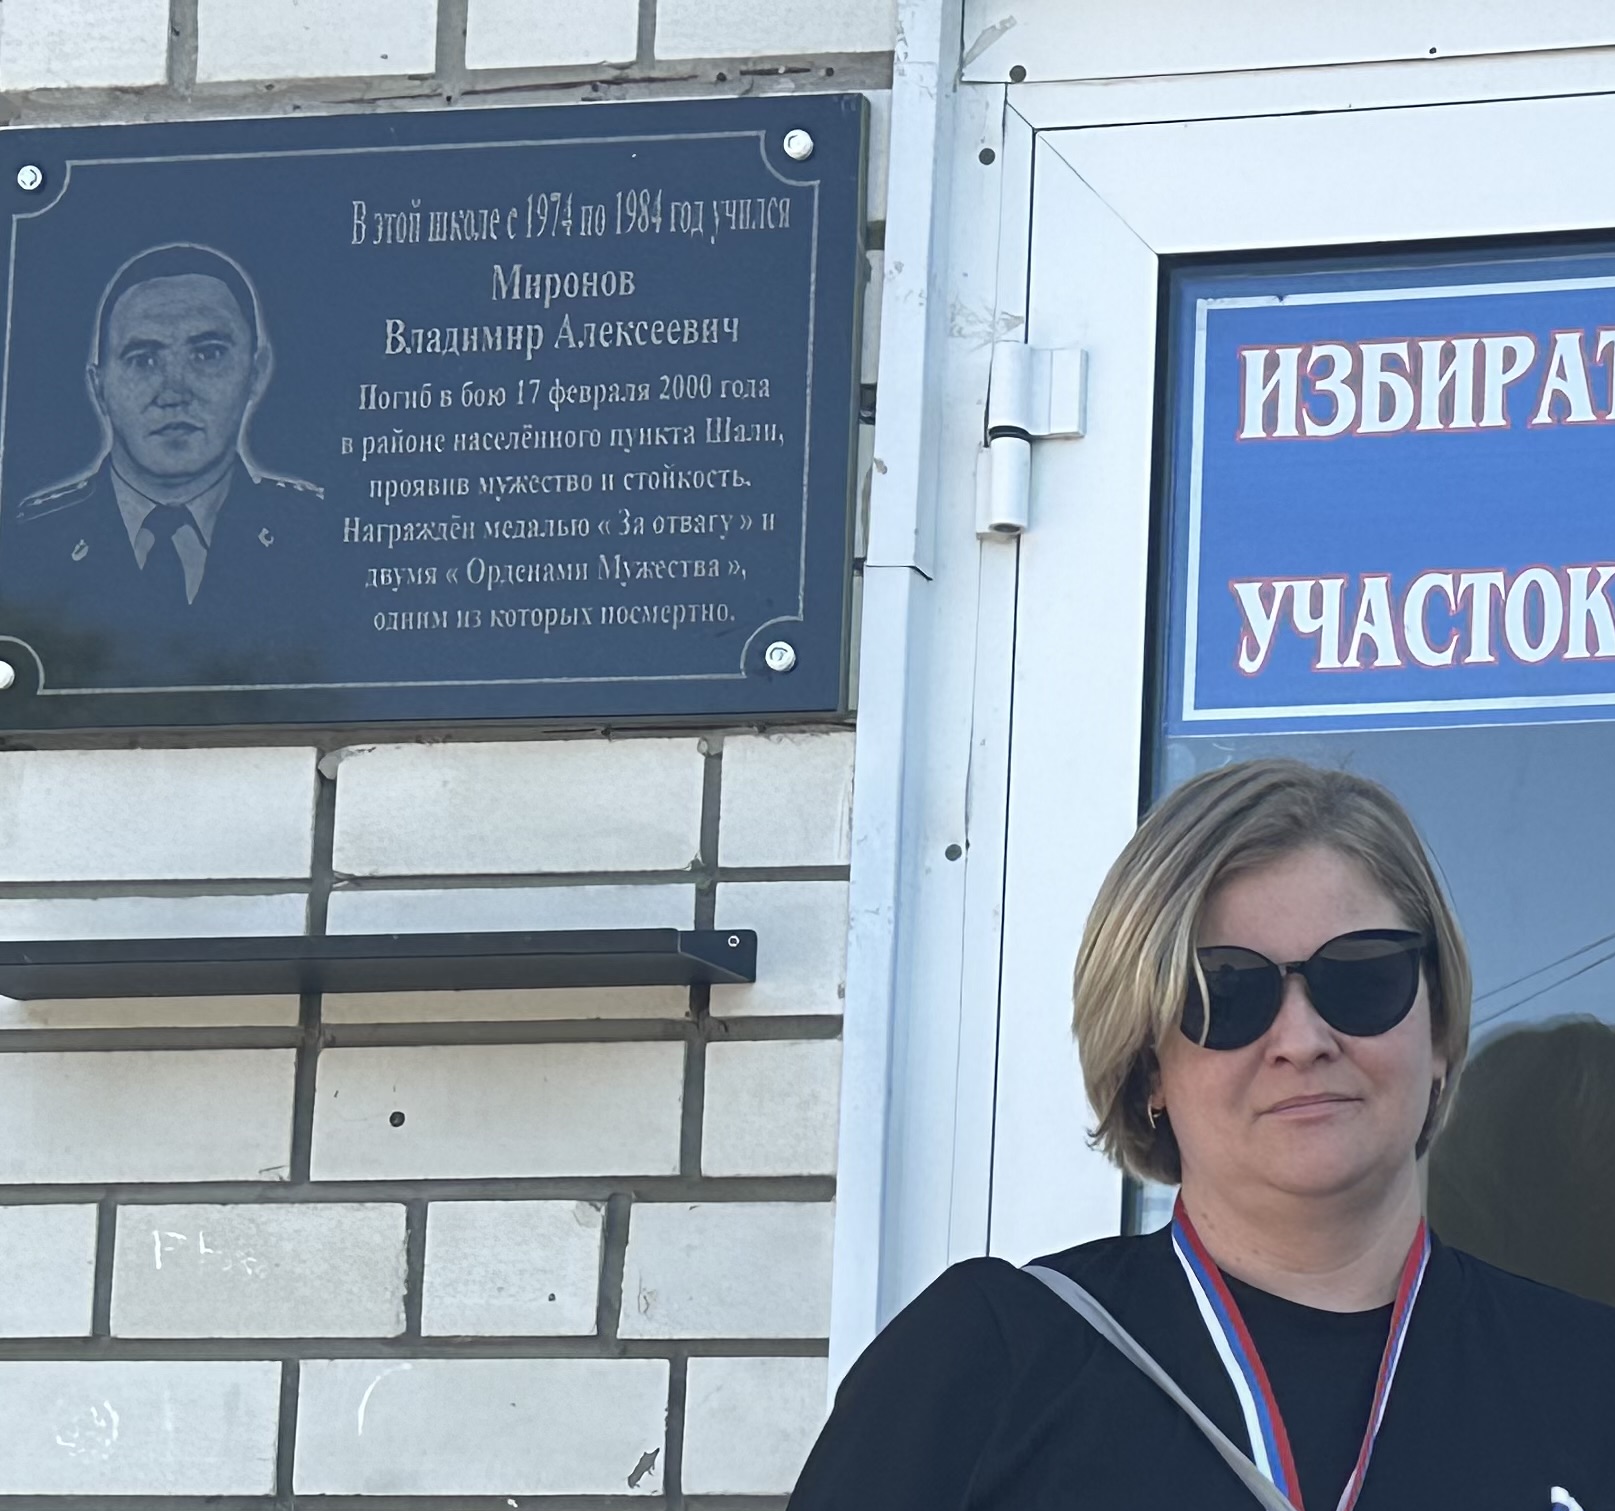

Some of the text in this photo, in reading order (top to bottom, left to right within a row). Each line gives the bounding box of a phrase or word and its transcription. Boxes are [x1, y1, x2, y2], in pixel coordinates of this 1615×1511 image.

[351, 188, 791, 245] В этой школе с 1974 по 1984 год учился
[491, 264, 636, 309] Миронов
[384, 313, 739, 361] Владимир Алексеевич
[358, 373, 770, 412] Погиб в бою 17 февраля 2000 года
[341, 416, 785, 462] в районе населённого пункта Шали,
[369, 463, 752, 506] проявив мужество и стойкость.
[342, 514, 475, 549] Награждён
[483, 518, 590, 540] медалью
[652, 513, 734, 541] отвагу
[761, 512, 775, 531] и
[365, 567, 438, 592] двумя
[373, 603, 735, 634] одним из которых посмертно.
